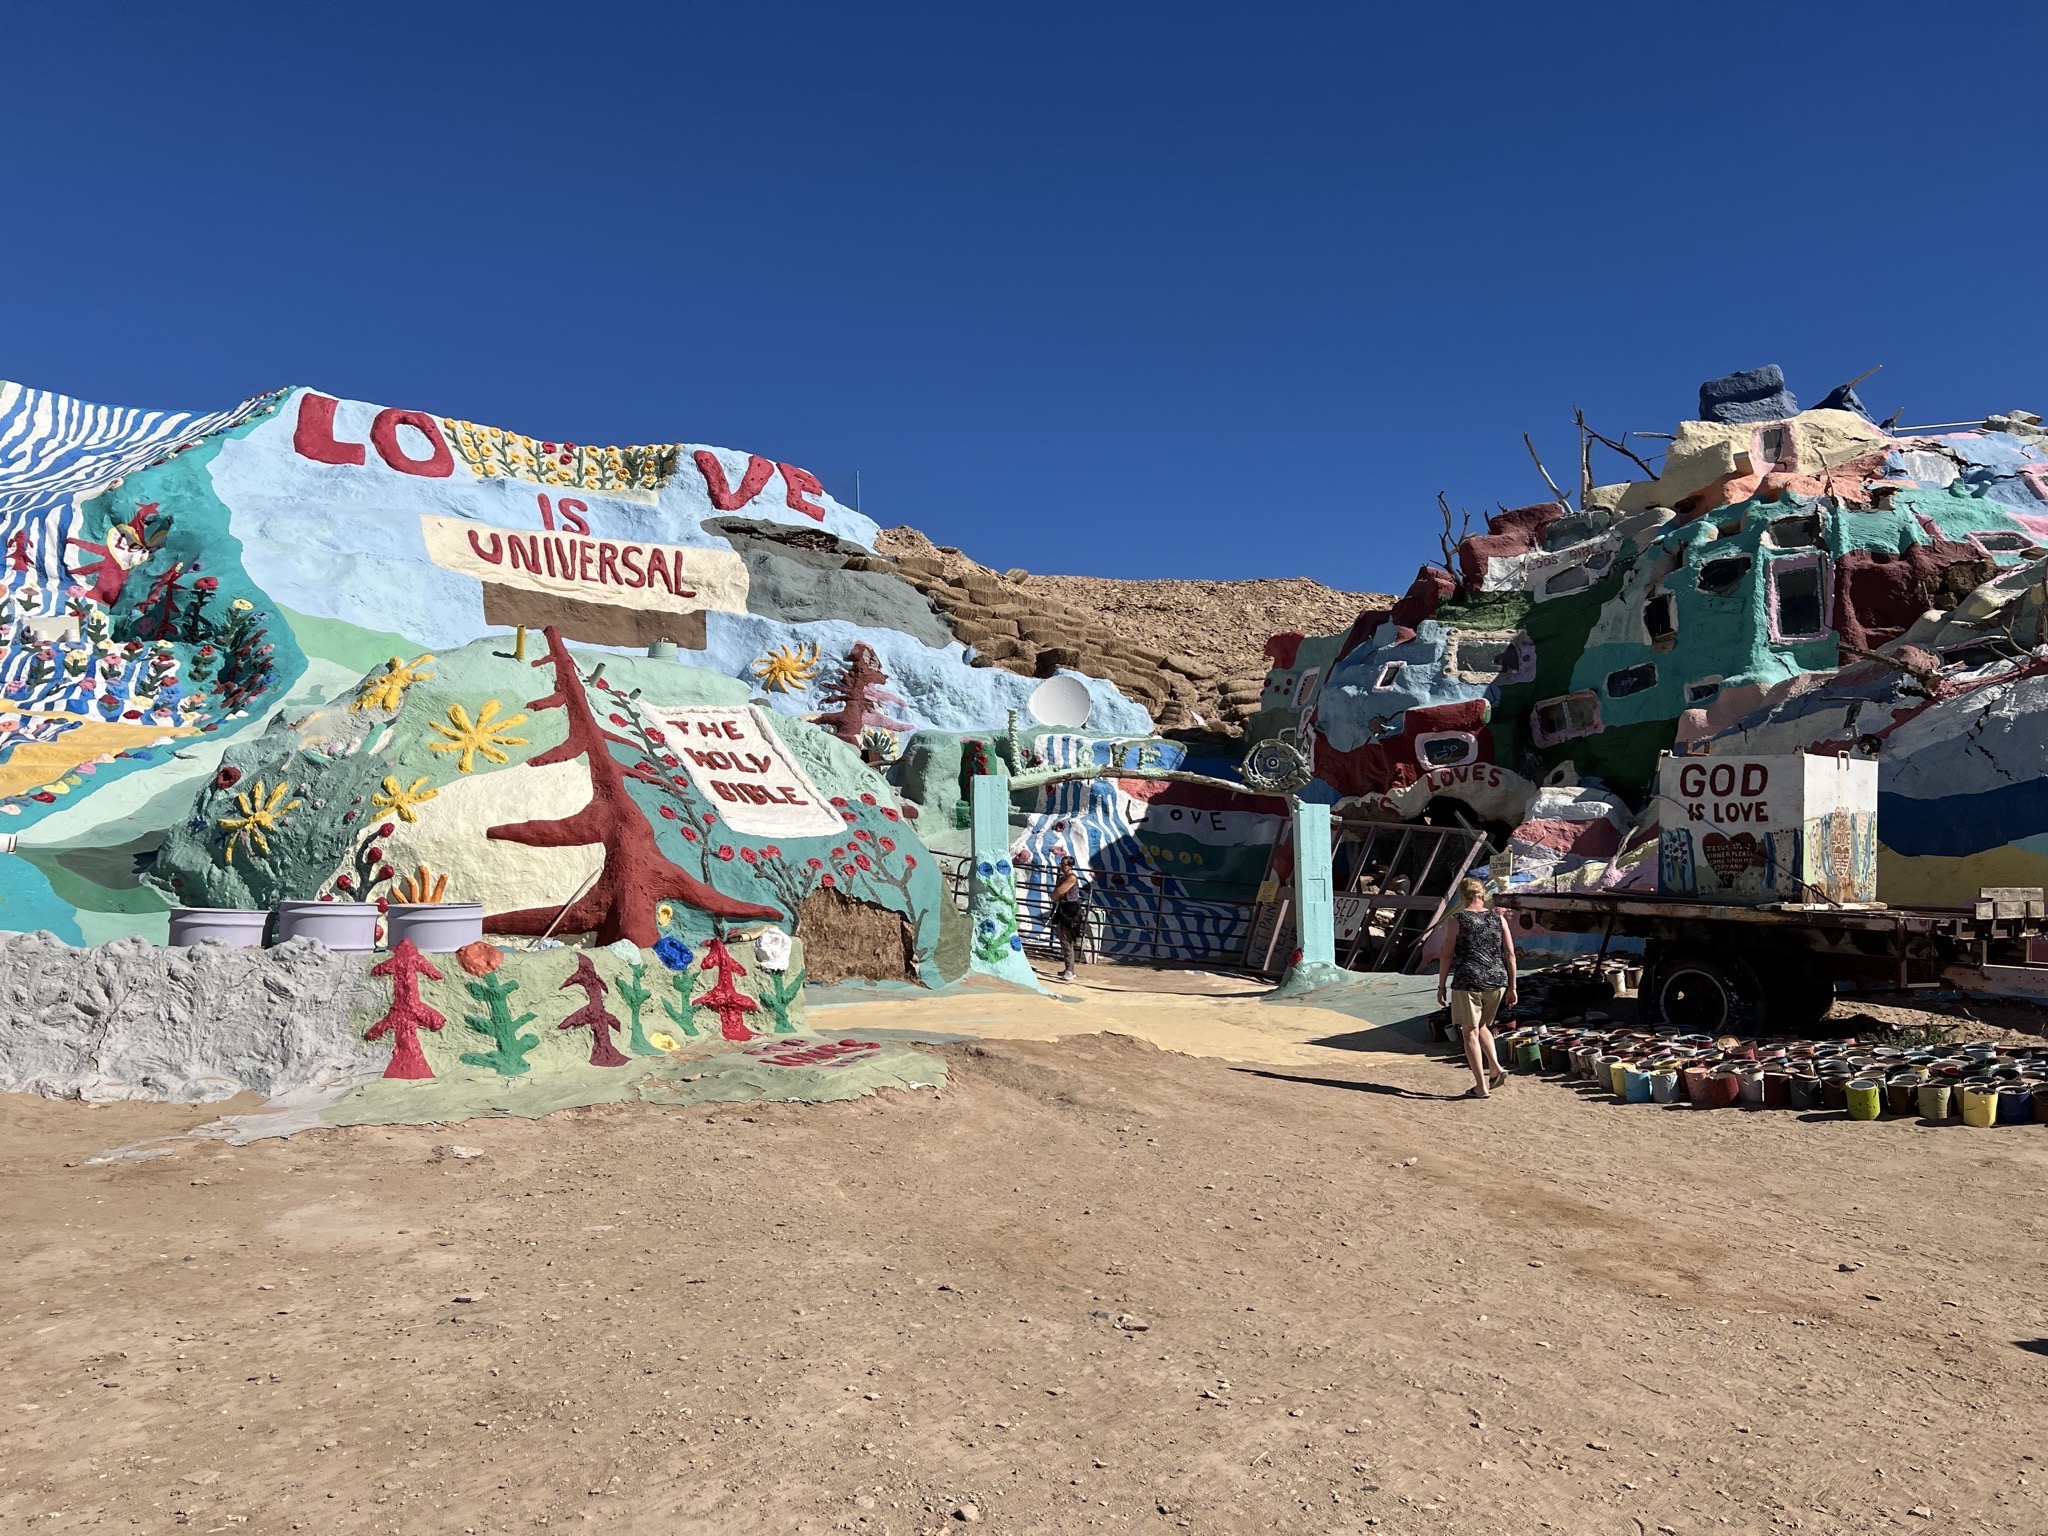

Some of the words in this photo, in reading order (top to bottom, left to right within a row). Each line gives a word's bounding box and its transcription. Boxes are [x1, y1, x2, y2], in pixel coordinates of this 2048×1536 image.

[537, 493, 590, 536] IS
[468, 530, 697, 598] UNIVERSAL
[666, 720, 745, 740] THE
[1007, 708, 1168, 777] LOVE
[684, 747, 771, 774] HOLY
[1426, 762, 1502, 793] LOVES
[1680, 763, 1768, 798] GOD
[710, 779, 809, 806] BIBLE
[1125, 799, 1227, 831] LOVE
[1687, 803, 1705, 821] IS
[1713, 801, 1769, 823] LOVE
[1705, 844, 1730, 852] JESUS
[1706, 851, 1730, 859] SINNER
[1333, 898, 1360, 918] SED
[1251, 929, 1269, 965] WET
